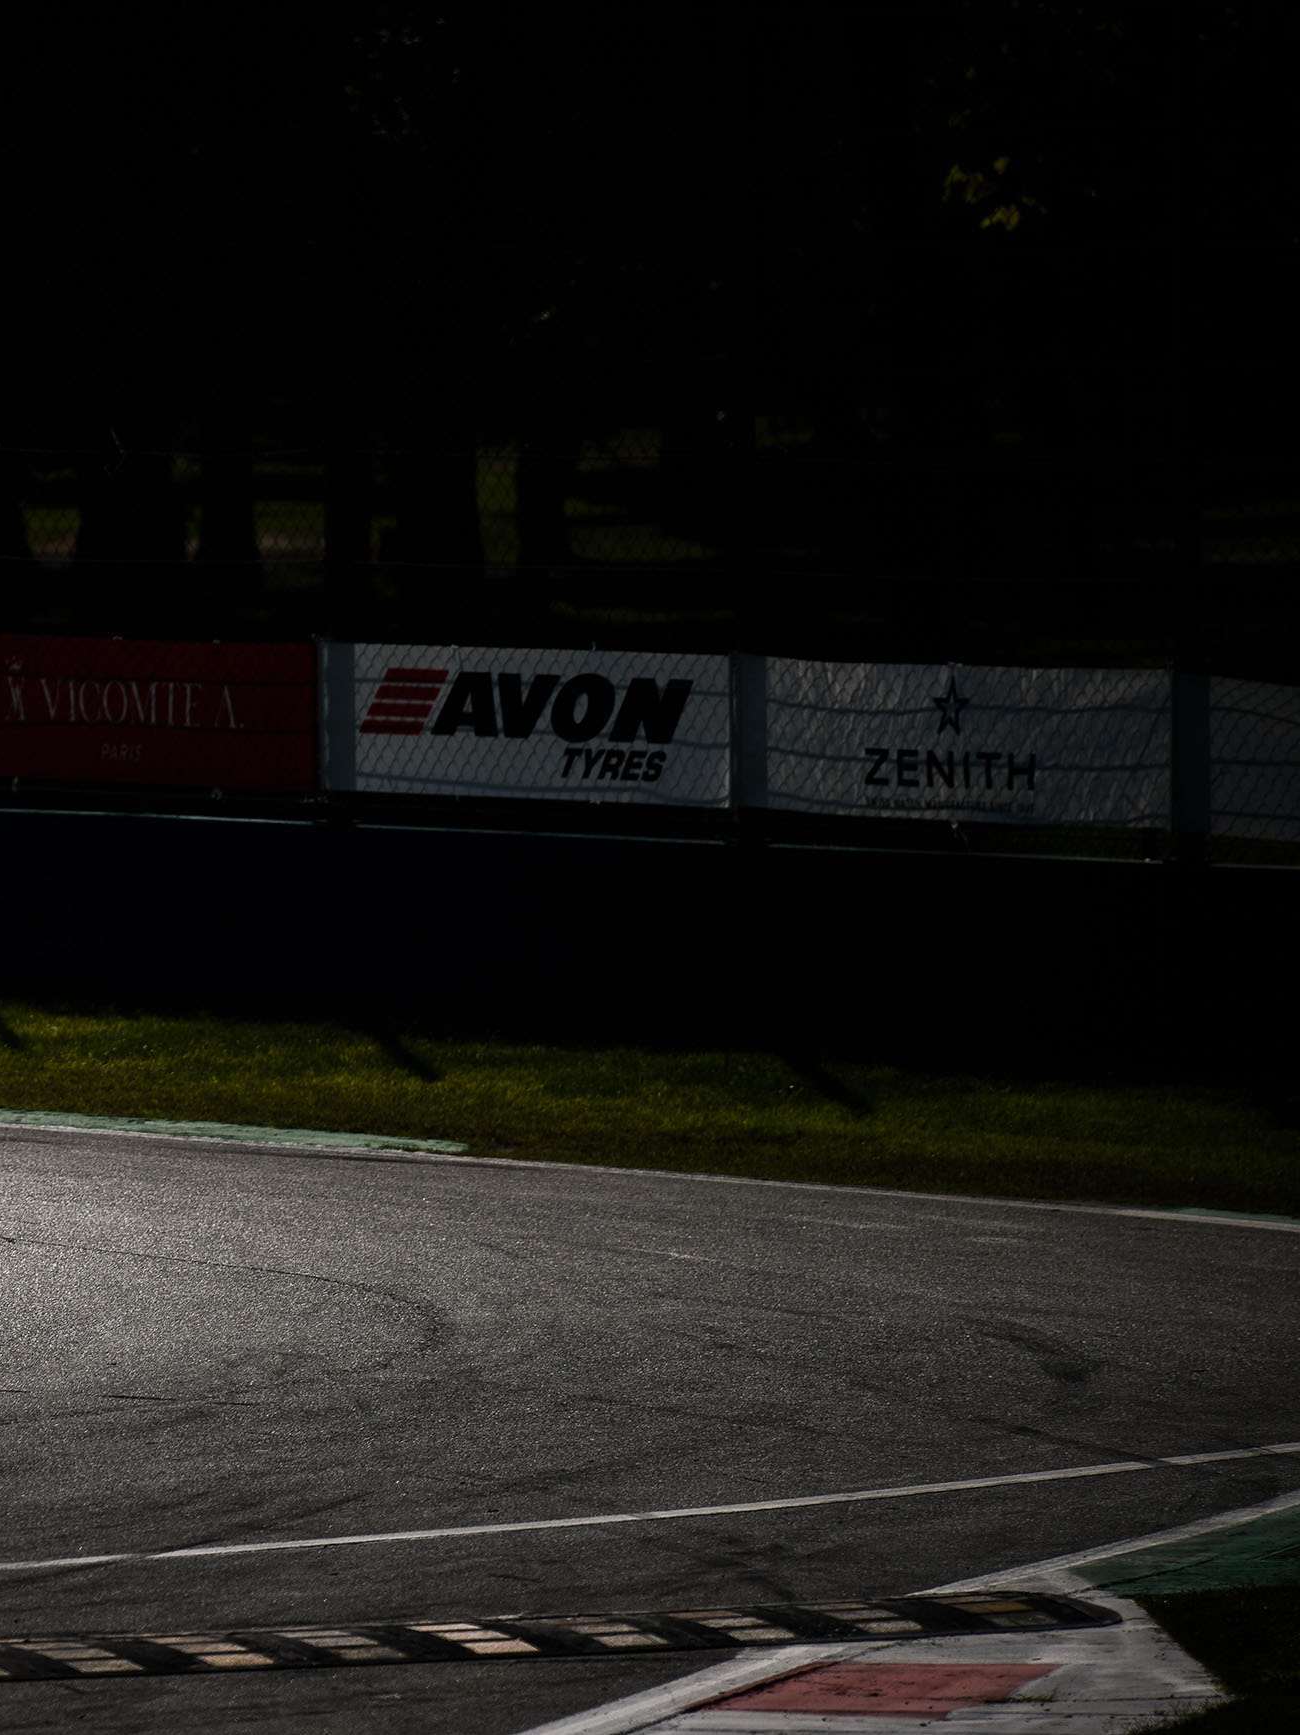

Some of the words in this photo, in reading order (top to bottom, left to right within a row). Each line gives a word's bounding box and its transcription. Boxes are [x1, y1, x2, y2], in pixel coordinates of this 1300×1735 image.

[39, 678, 205, 729] VICOMTE
[431, 671, 694, 744] AVON
[100, 744, 143, 761] PARIS
[561, 748, 667, 782] TYRES
[864, 748, 1036, 791] ZENITH
